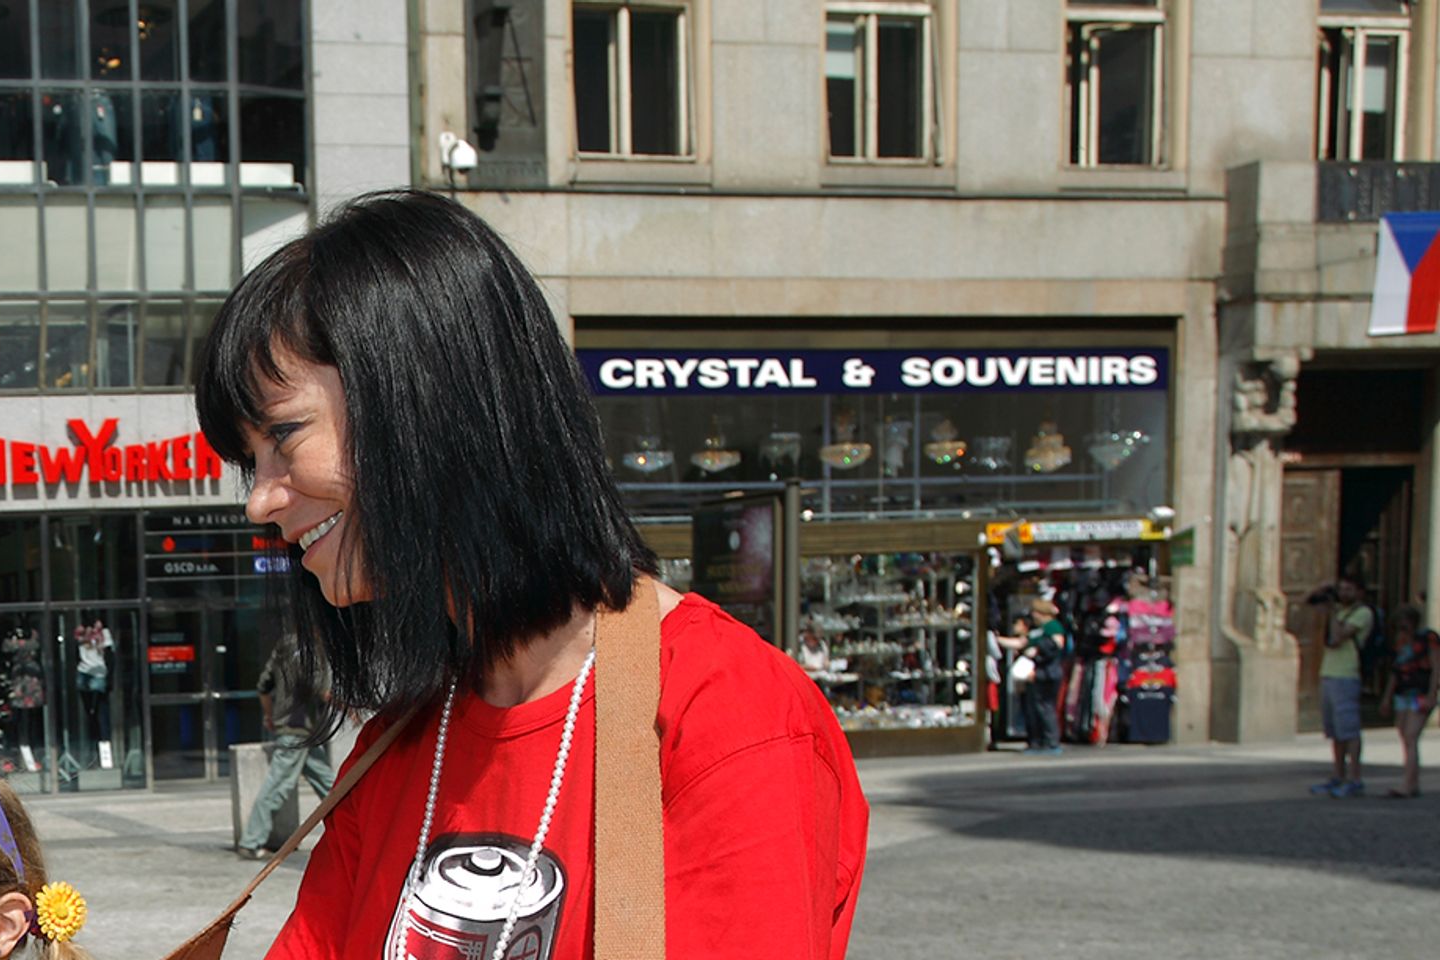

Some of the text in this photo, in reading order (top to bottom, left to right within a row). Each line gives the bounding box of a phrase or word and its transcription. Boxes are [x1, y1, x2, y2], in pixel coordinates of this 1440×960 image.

[598, 355, 1159, 389] CRYSTAL & SOUVENIRS
[198, 513, 247, 525] PŘÍKOP
